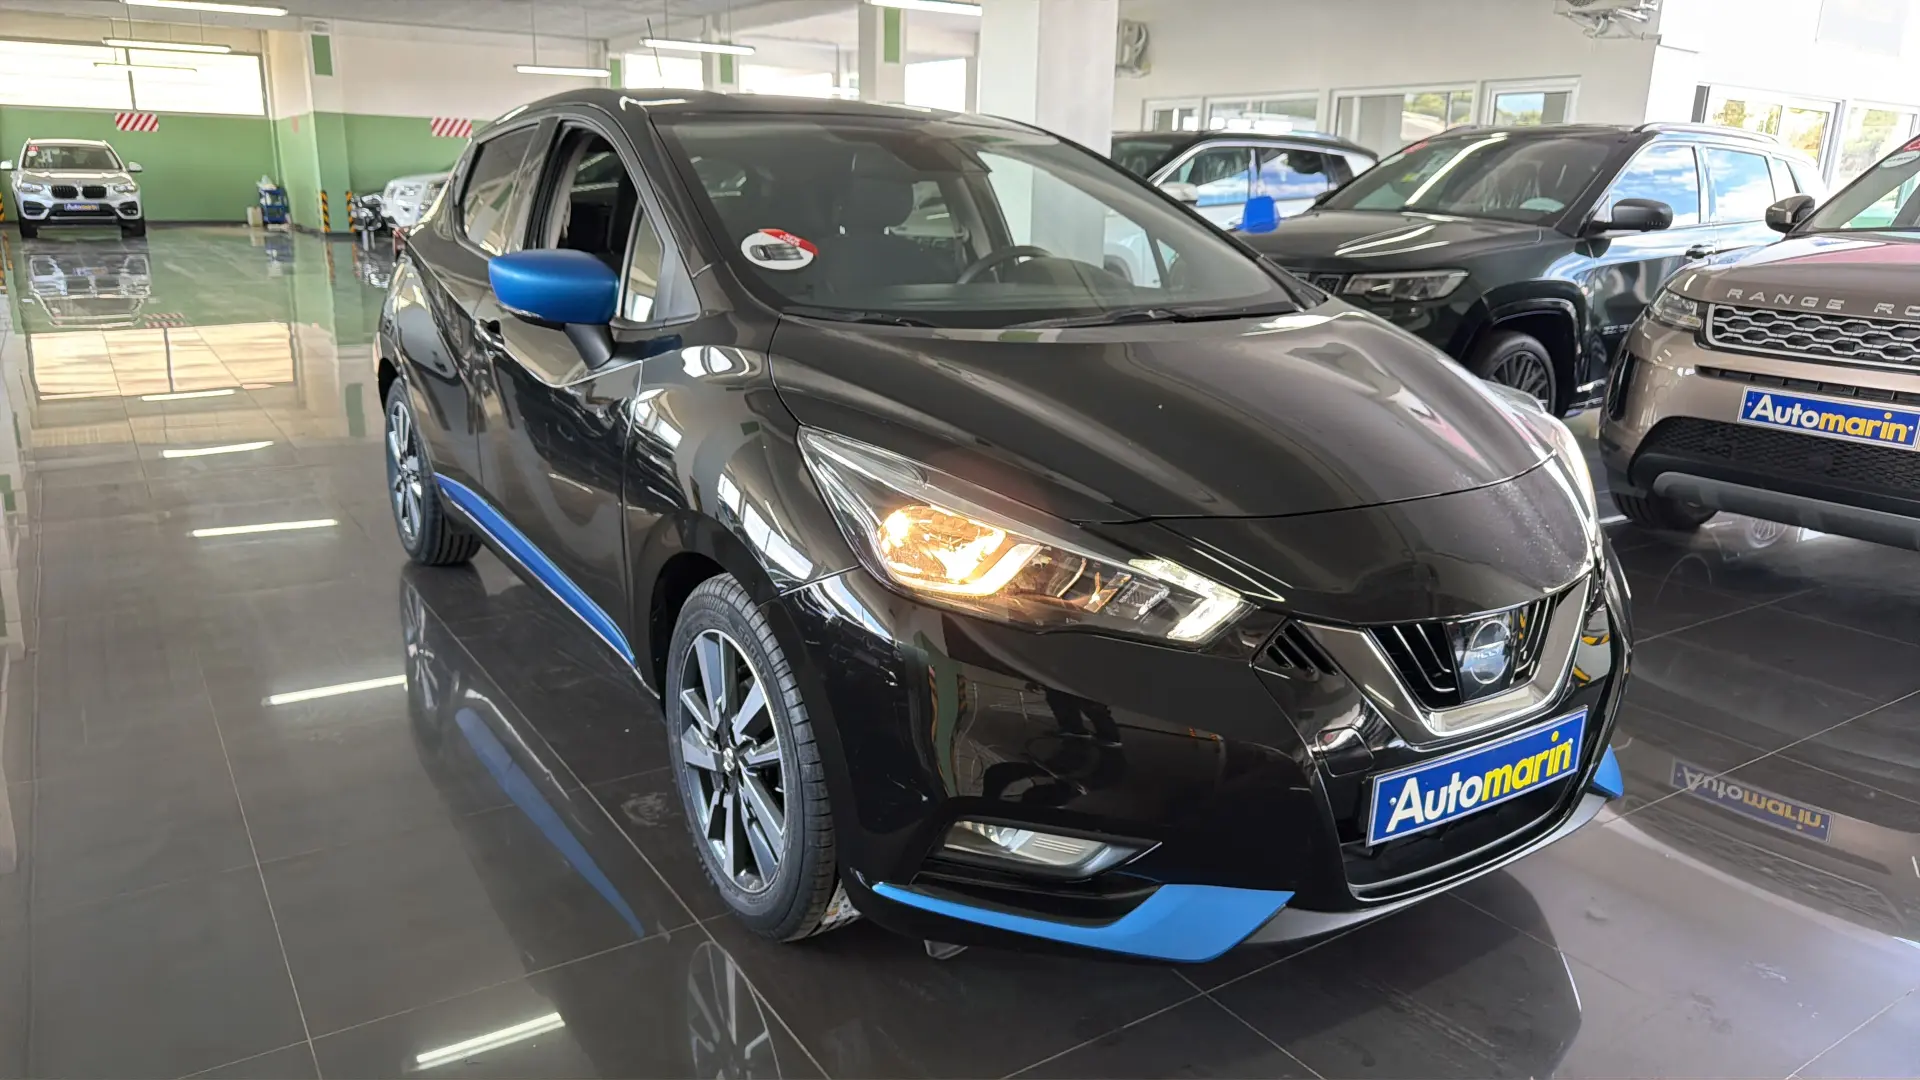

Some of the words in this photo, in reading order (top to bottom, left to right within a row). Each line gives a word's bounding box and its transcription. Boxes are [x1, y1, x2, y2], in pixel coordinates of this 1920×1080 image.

[1727, 288, 1845, 311] RANGE
[1874, 302, 1920, 317] RO
[1750, 394, 1908, 442] Automarin
[1385, 731, 1572, 833] Automarin
